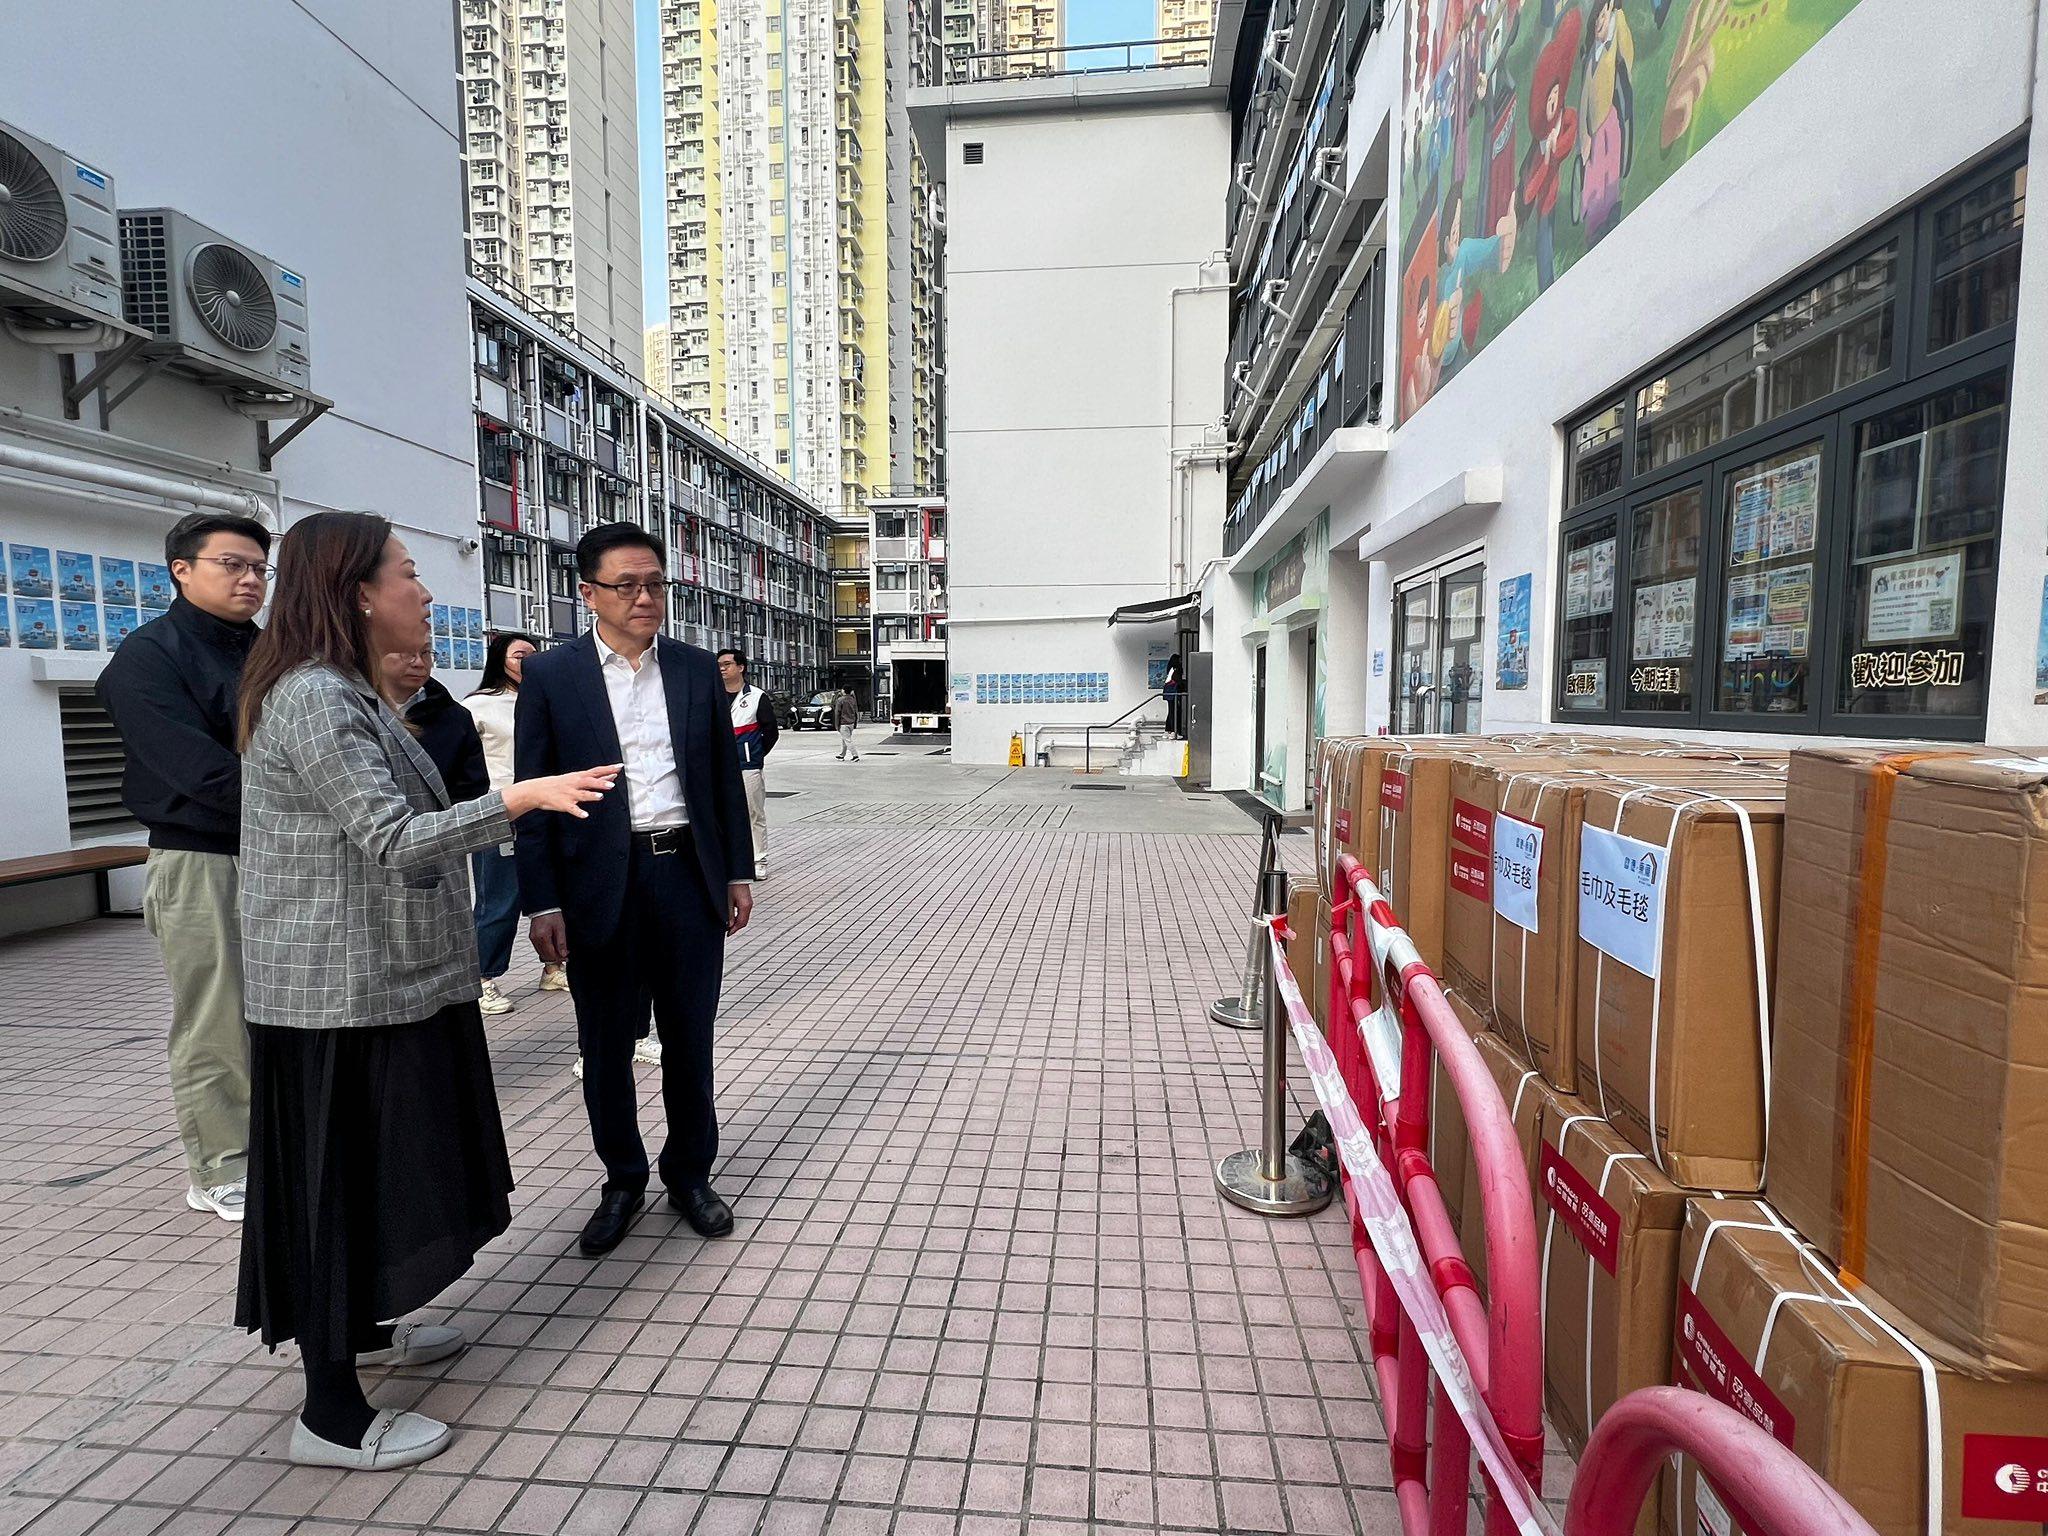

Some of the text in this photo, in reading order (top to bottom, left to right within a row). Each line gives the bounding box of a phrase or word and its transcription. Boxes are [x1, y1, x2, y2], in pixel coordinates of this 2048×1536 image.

[1631, 666, 1681, 694] 今期活動
[1852, 649, 1964, 688] 歡迎參加
[1493, 851, 1532, 890] 毛巾及毛毯
[1581, 870, 1649, 923] 毛巾及毛毯
